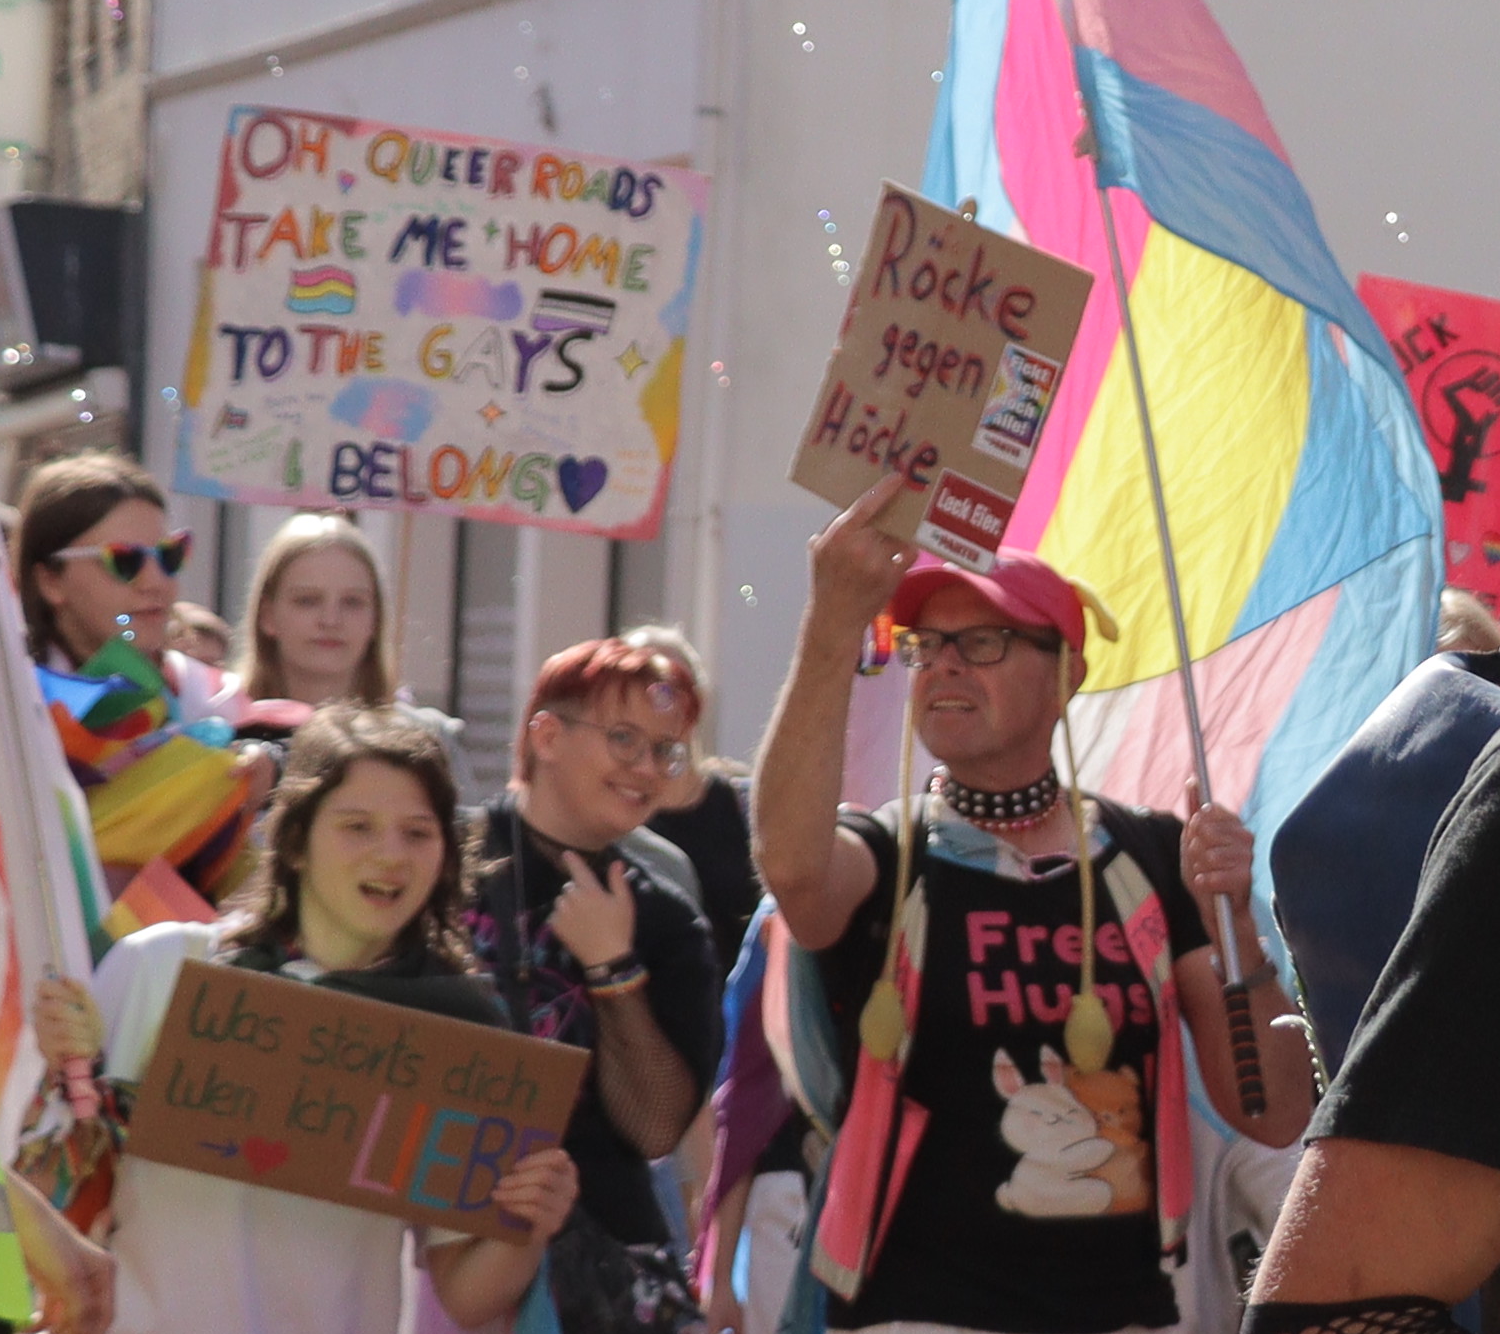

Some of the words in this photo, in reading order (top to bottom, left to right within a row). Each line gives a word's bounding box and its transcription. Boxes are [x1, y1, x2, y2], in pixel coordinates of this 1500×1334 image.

[241, 114, 330, 180] OH
[366, 131, 520, 200] QUEER
[529, 154, 663, 217] ROADS
[219, 206, 368, 271] TAKE
[390, 214, 467, 268] ME
[503, 222, 655, 293] HOME
[871, 192, 1036, 341] Röcke
[219, 323, 294, 383] TO
[298, 324, 385, 375] THE
[419, 323, 592, 394] GAYS
[874, 323, 985, 398] gegen
[1390, 314, 1459, 376] UCK
[283, 438, 302, 488] I
[329, 441, 554, 512] BELONG
[811, 379, 938, 492] Höcke
[935, 487, 971, 521] Leck
[973, 503, 1001, 535] Eier.
[965, 910, 1131, 964] Free
[188, 981, 283, 1053] Was
[442, 1051, 539, 1111] dich
[165, 1059, 257, 1120] Wen
[286, 1075, 358, 1143] ich
